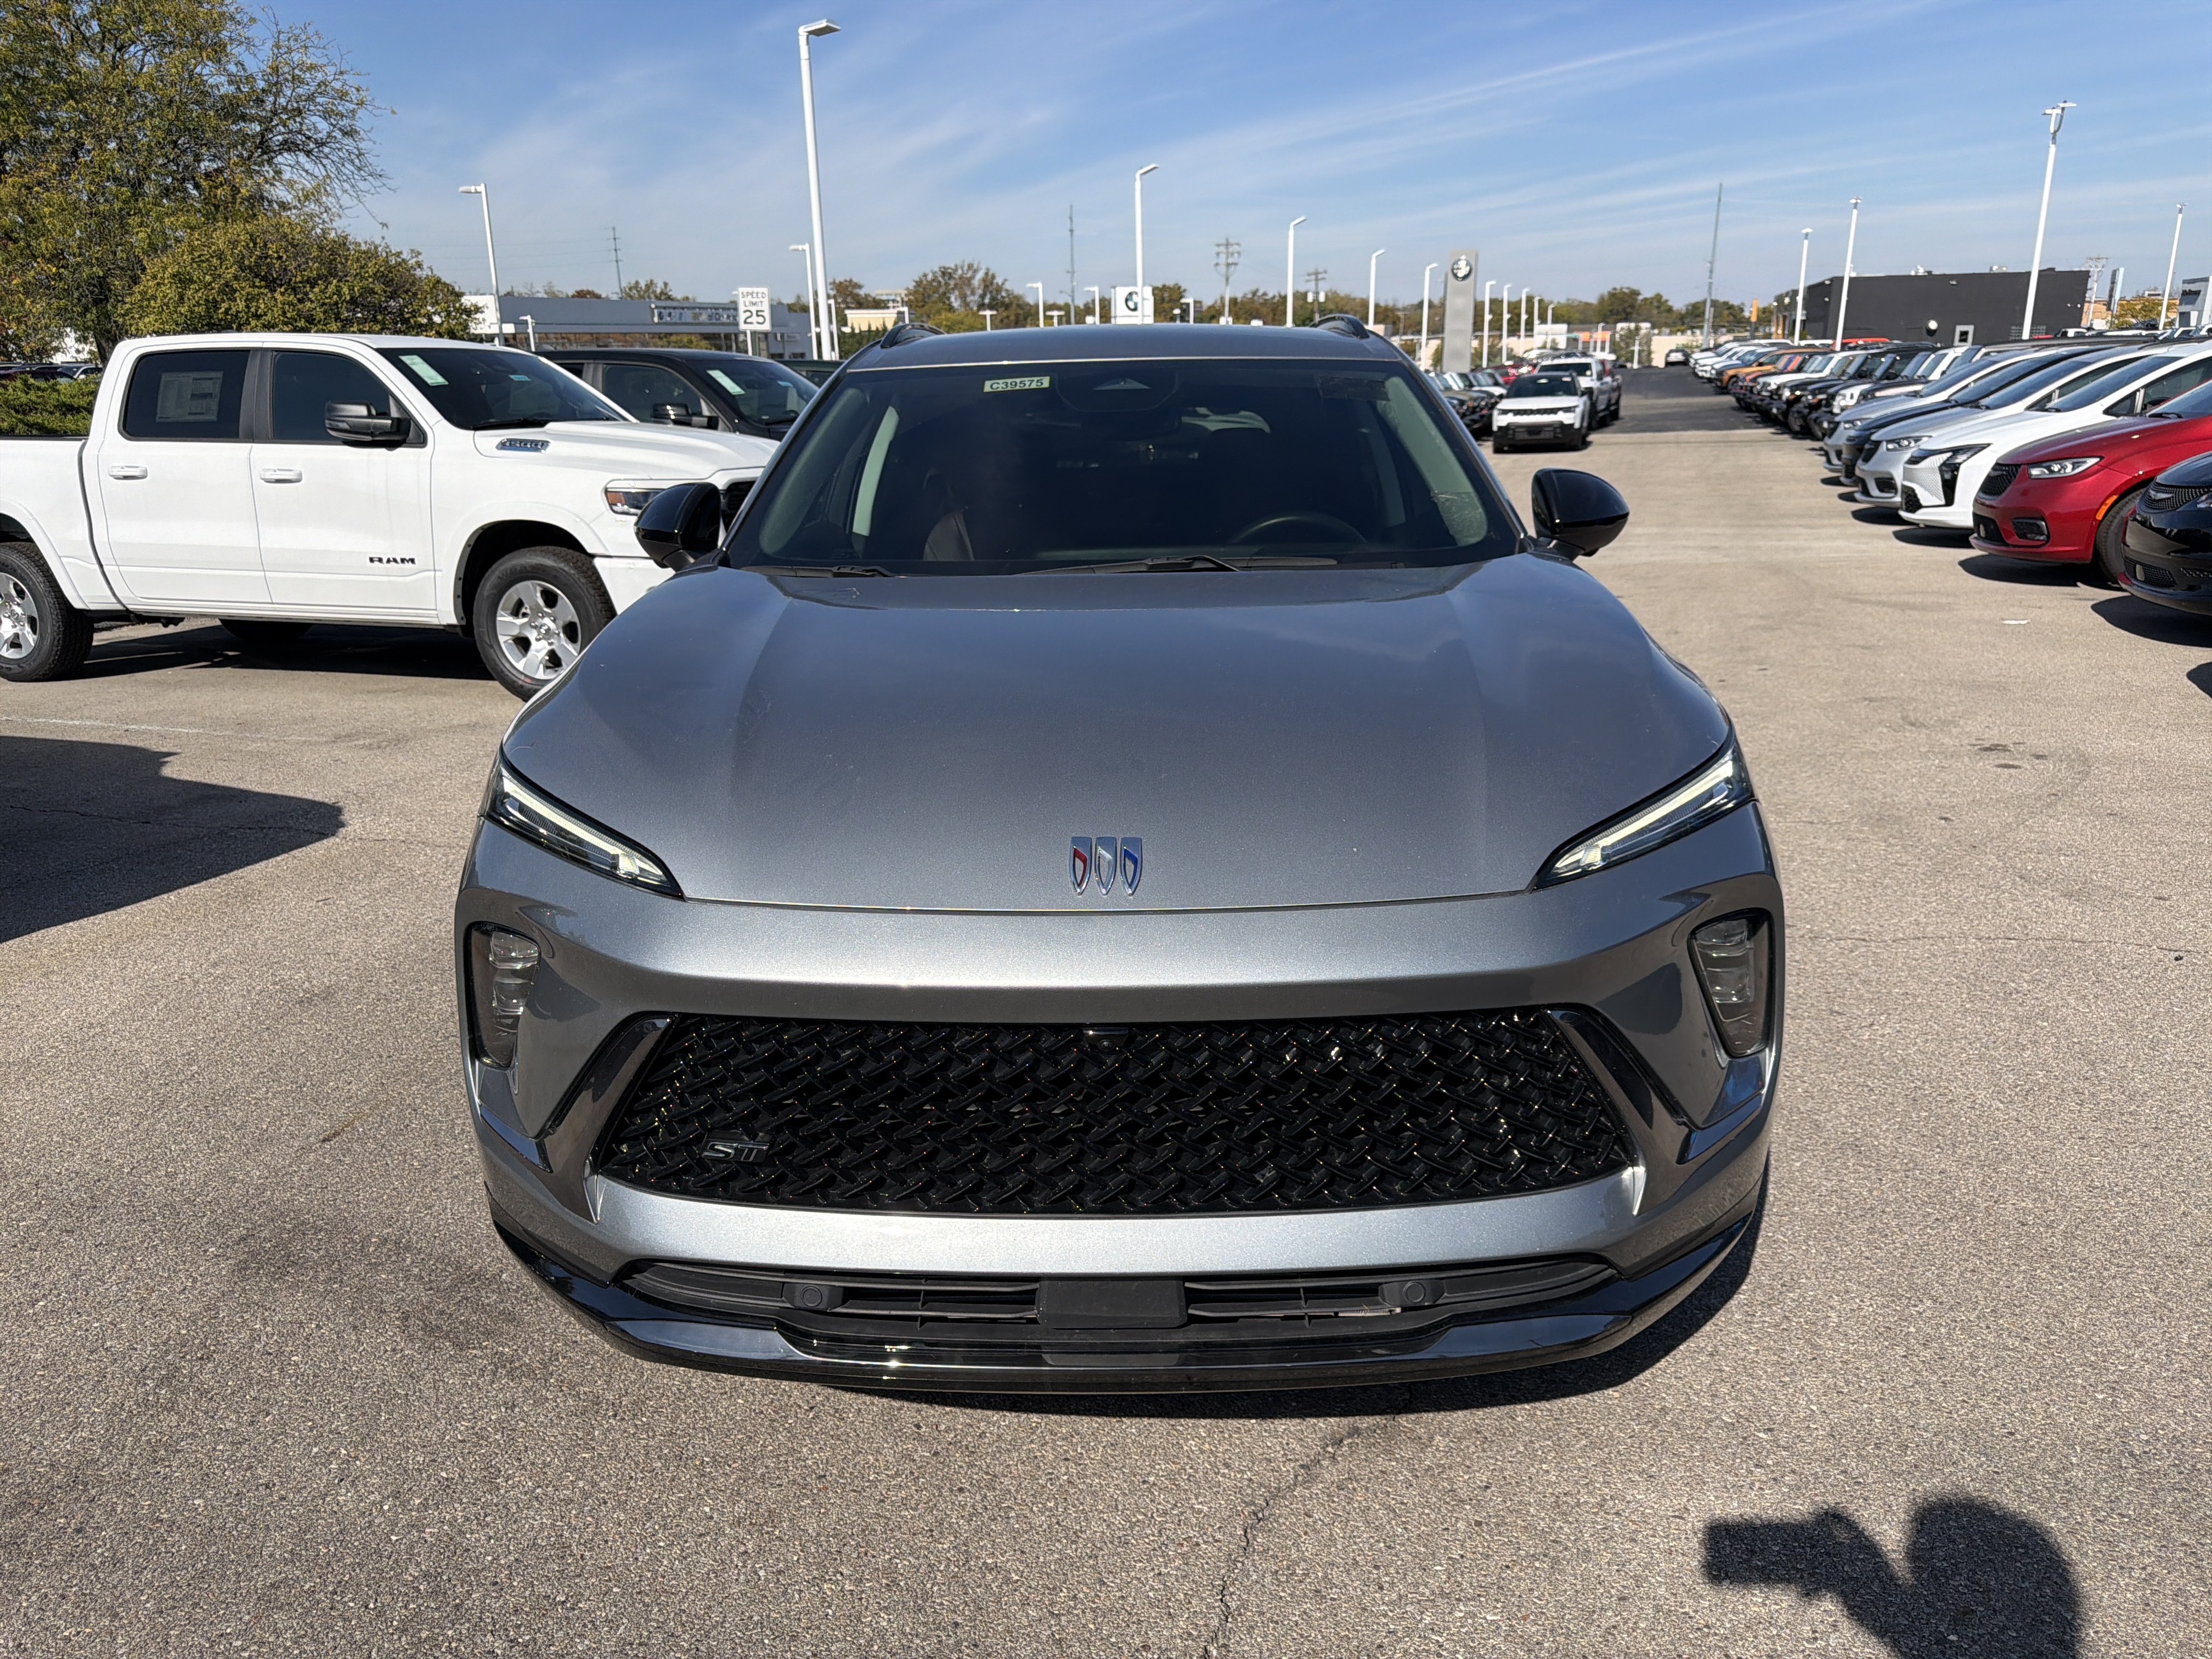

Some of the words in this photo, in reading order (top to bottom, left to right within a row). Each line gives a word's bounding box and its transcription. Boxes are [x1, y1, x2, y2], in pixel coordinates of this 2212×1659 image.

[741, 291, 766, 299] SPEED
[743, 309, 766, 325] 25
[990, 379, 1044, 390] C39575
[369, 556, 416, 565] RAM
[702, 1141, 770, 1162] ST
